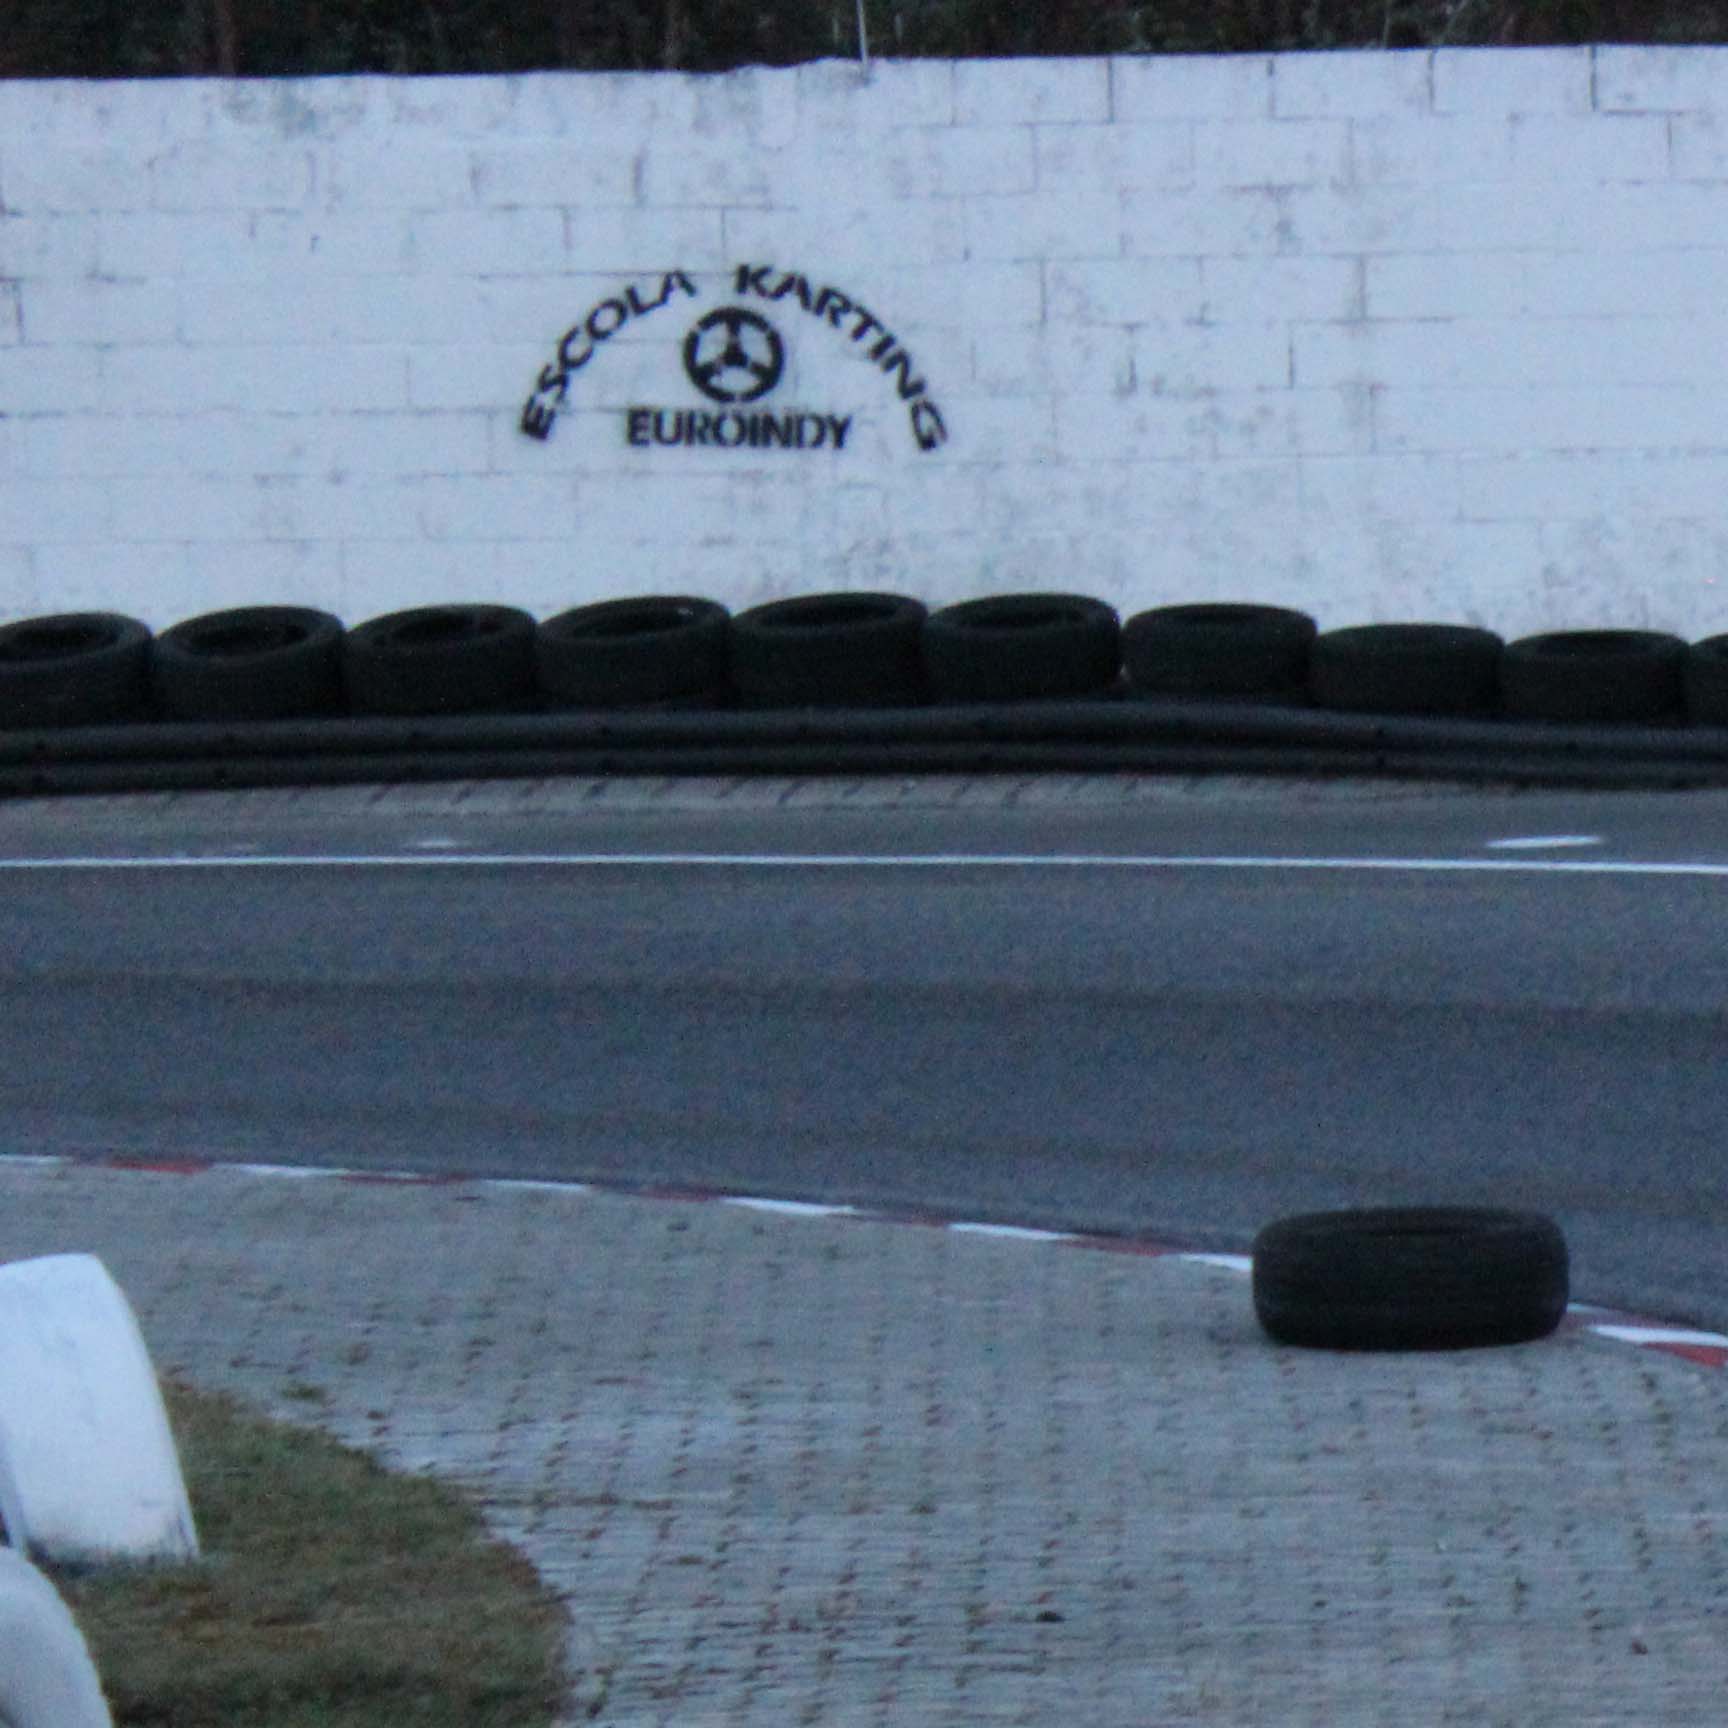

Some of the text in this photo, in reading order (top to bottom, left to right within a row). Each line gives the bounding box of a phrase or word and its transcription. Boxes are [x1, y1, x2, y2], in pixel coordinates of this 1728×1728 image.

[520, 263, 948, 452] ESCOLA KARTING
[625, 405, 853, 450] EUROINDY
